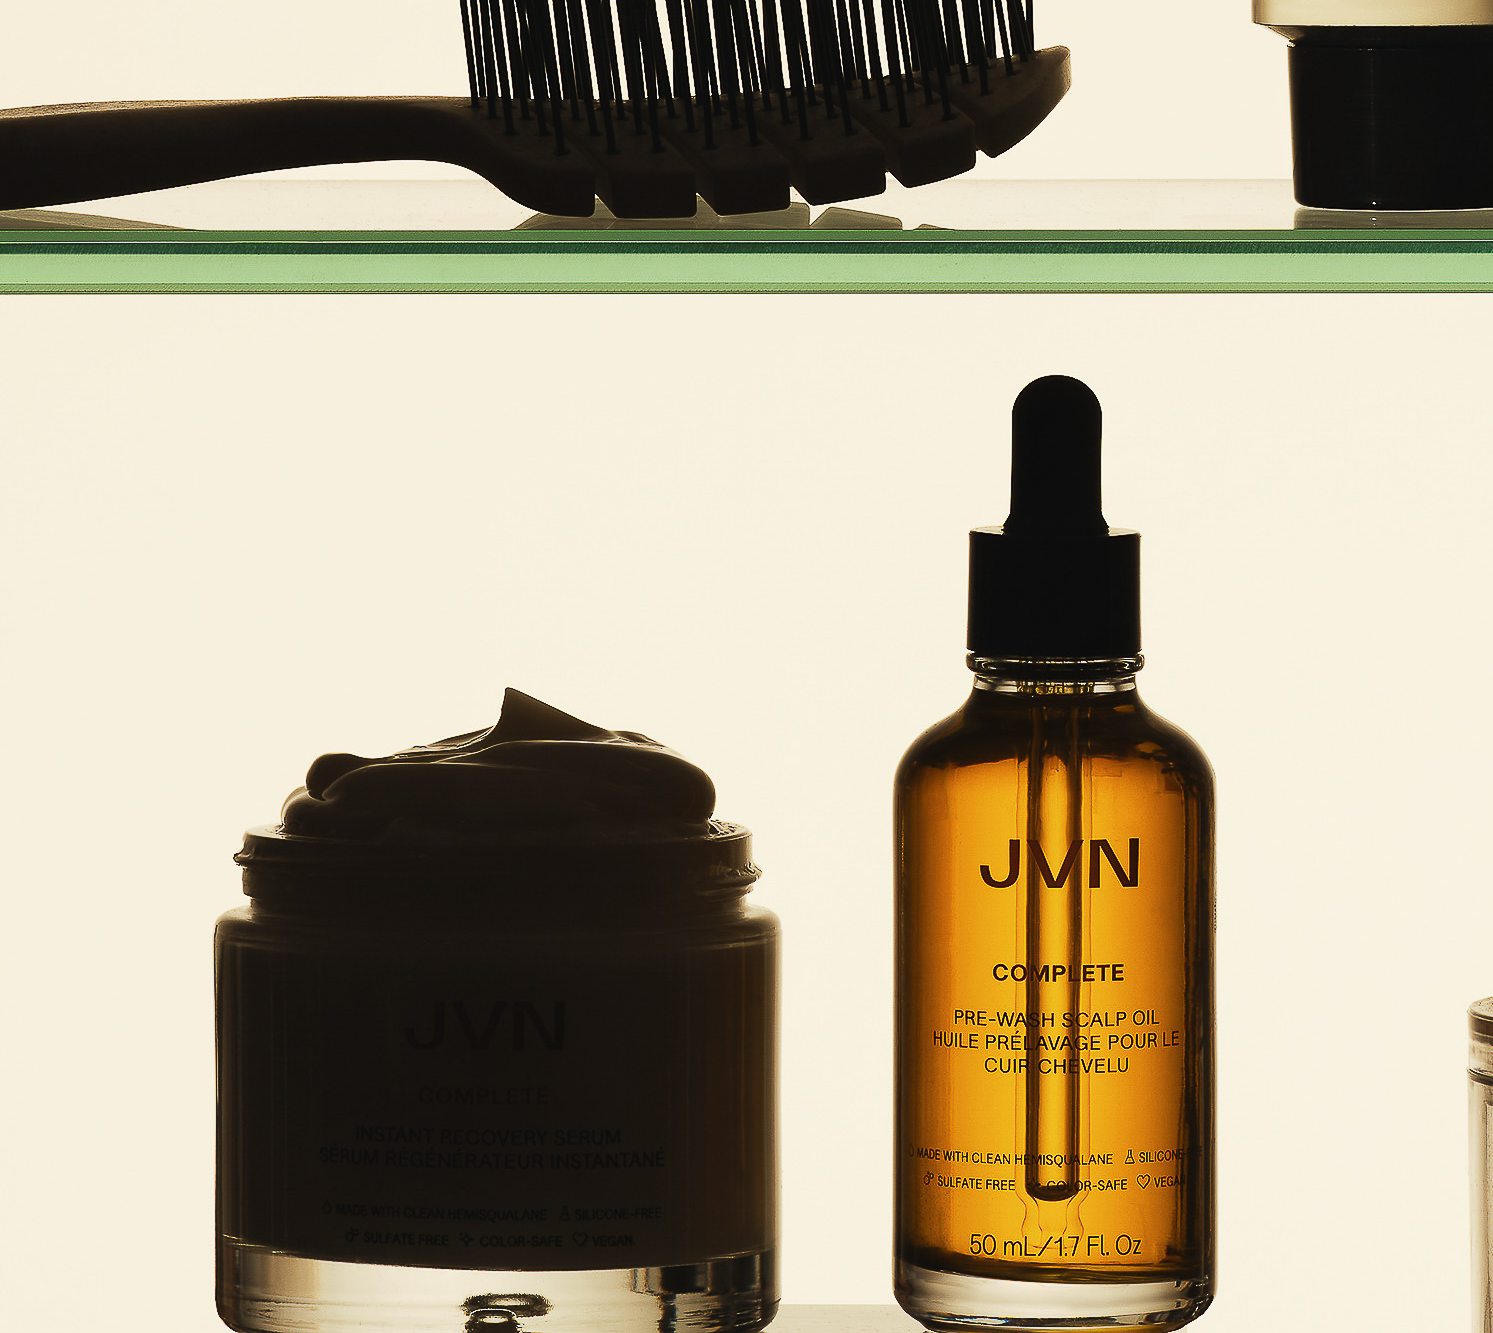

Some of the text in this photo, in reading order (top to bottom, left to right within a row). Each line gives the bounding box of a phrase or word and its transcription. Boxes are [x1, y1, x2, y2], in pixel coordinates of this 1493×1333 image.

[979, 837, 1140, 889] JVN
[992, 963, 1125, 982] COMPLETE
[404, 1000, 566, 1052] JVN
[953, 1009, 1160, 1029] PRE-WASH SCALP OIL
[932, 1029, 1180, 1052] HUILE PRÉLAVAGE POUR LE
[983, 1056, 1129, 1075] CUIR CHEVELU
[418, 1086, 551, 1106] COMPLETE
[355, 1125, 622, 1146] INSTANT RECOVERY SERUM
[319, 1143, 665, 1170] SÉRUM RÉGÉNÉRATEUR INSTANTANÉ
[917, 1145, 1203, 1168] MADE WITH CLEAN HEMISQUALANE SILICONE-EE
[937, 1175, 1186, 1192] SULFATE FREE COLOR-SAFE VEGAN
[335, 1202, 662, 1223] MADE WITH CLEAN HEMISQUALANE SILICONE-FREE
[363, 1230, 633, 1248] SULFATE FREE COLOR-SAFE VEGAN
[969, 1233, 997, 1255] 50
[1087, 1234, 1110, 1257] Fl.
[1115, 1235, 1142, 1256] Oz
